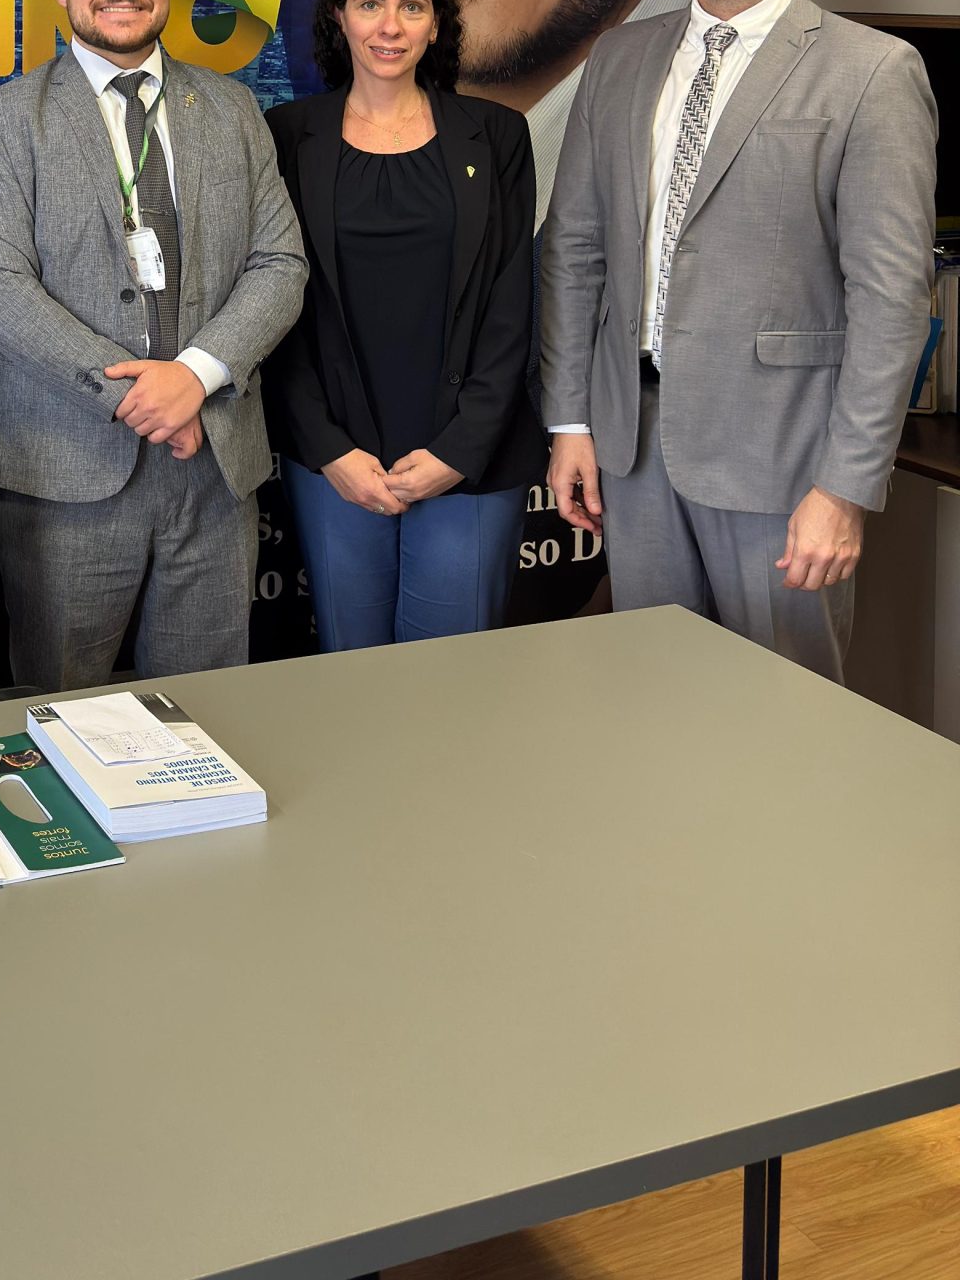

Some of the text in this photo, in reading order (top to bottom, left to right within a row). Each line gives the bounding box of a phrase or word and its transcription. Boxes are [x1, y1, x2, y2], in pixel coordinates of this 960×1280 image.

[163, 756, 219, 769] DEPUTADOS
[136, 768, 231, 786] REGIMENTO INTERNO
[205, 775, 238, 786] CURSO
[32, 827, 70, 837] fortes
[40, 834, 71, 844] mais
[39, 840, 83, 852] somos
[43, 847, 90, 859] Juntos
